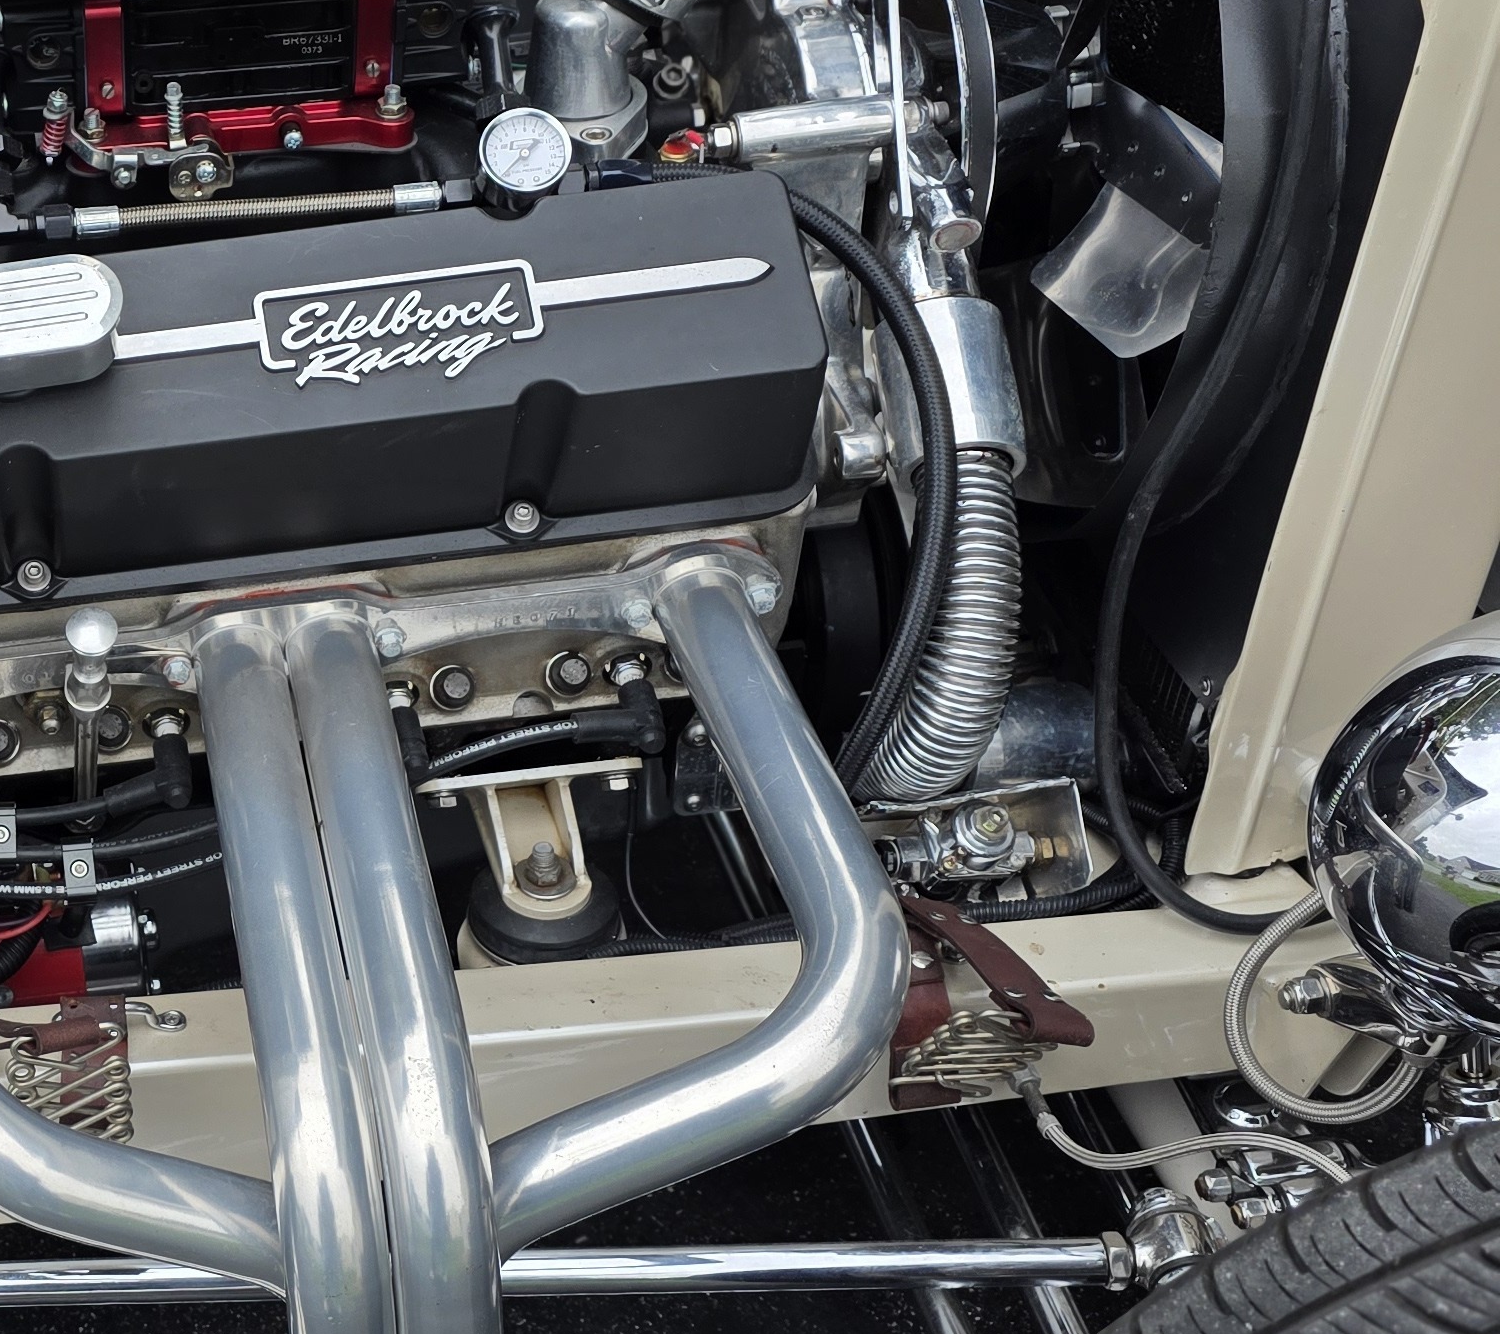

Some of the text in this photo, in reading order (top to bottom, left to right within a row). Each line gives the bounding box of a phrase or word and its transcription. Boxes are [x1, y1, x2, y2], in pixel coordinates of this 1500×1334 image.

[280, 281, 521, 352] Edelbrock
[294, 329, 508, 388] Racing
[499, 724, 551, 743] STREET
[155, 857, 204, 879] STREET
